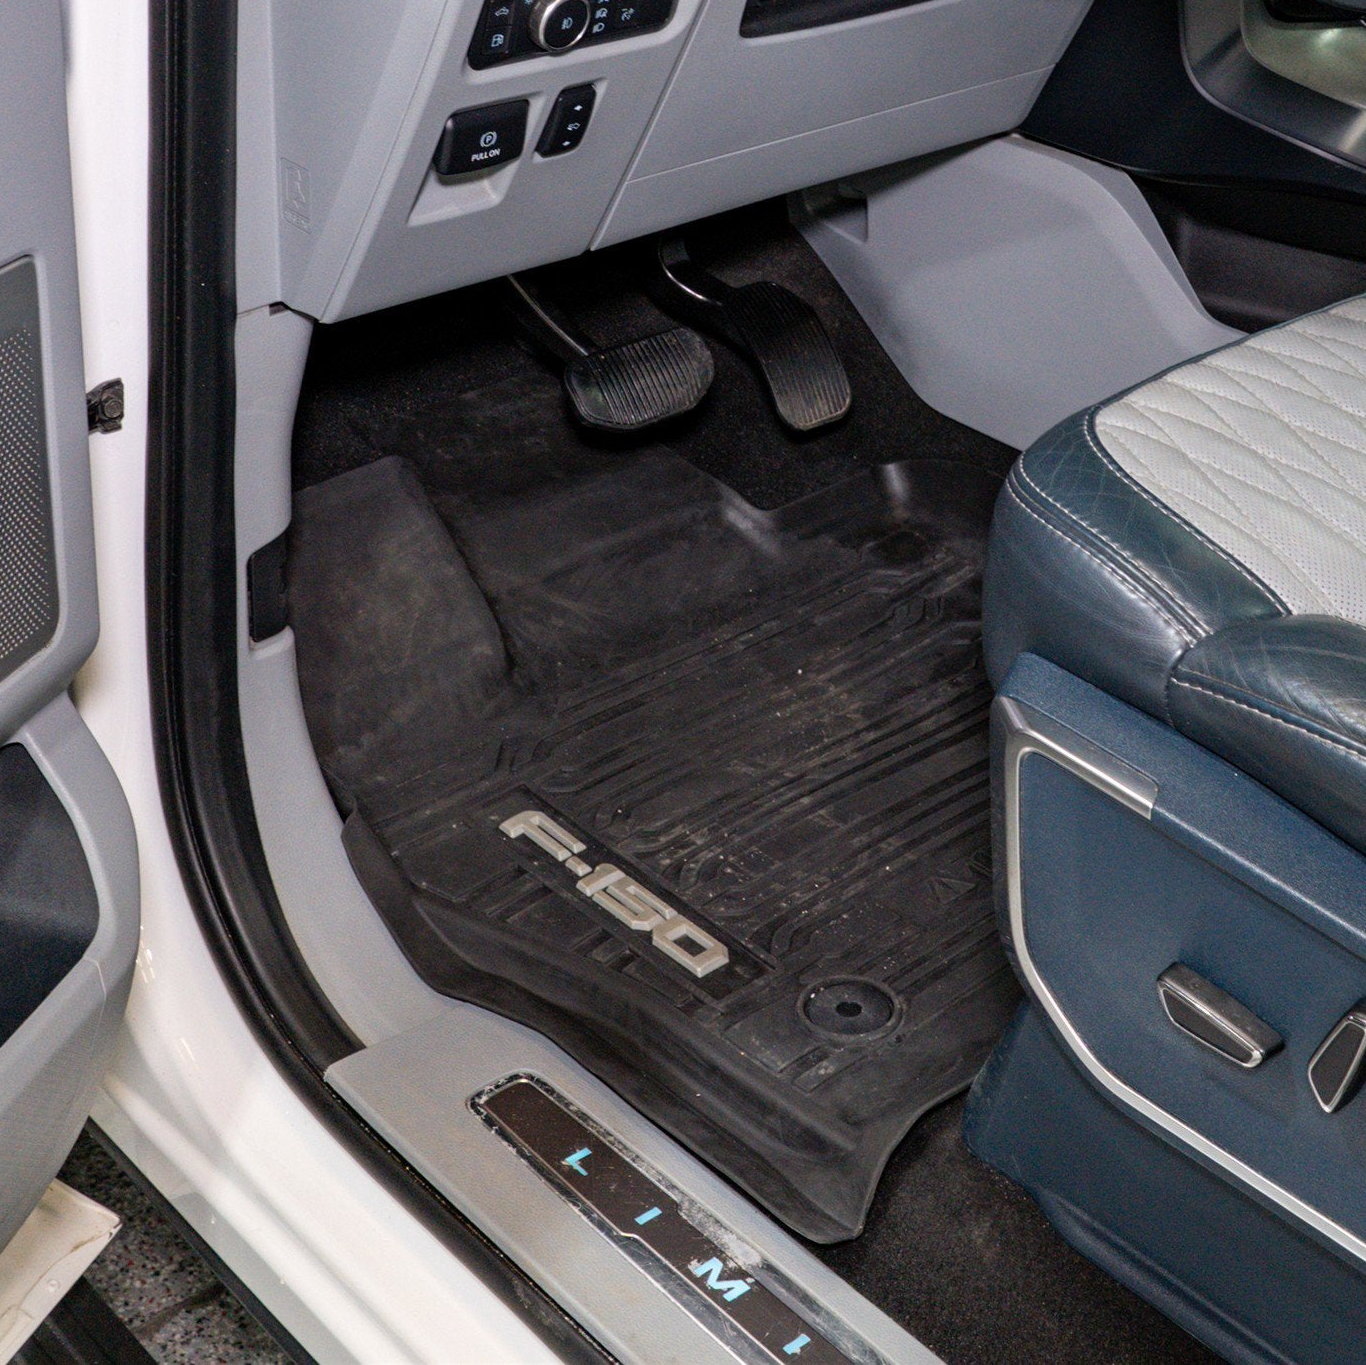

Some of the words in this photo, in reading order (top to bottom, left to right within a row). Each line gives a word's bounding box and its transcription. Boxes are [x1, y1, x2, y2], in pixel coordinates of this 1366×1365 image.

[471, 151, 488, 162] PULL
[488, 148, 501, 158] ON
[498, 810, 730, 978] F-150
